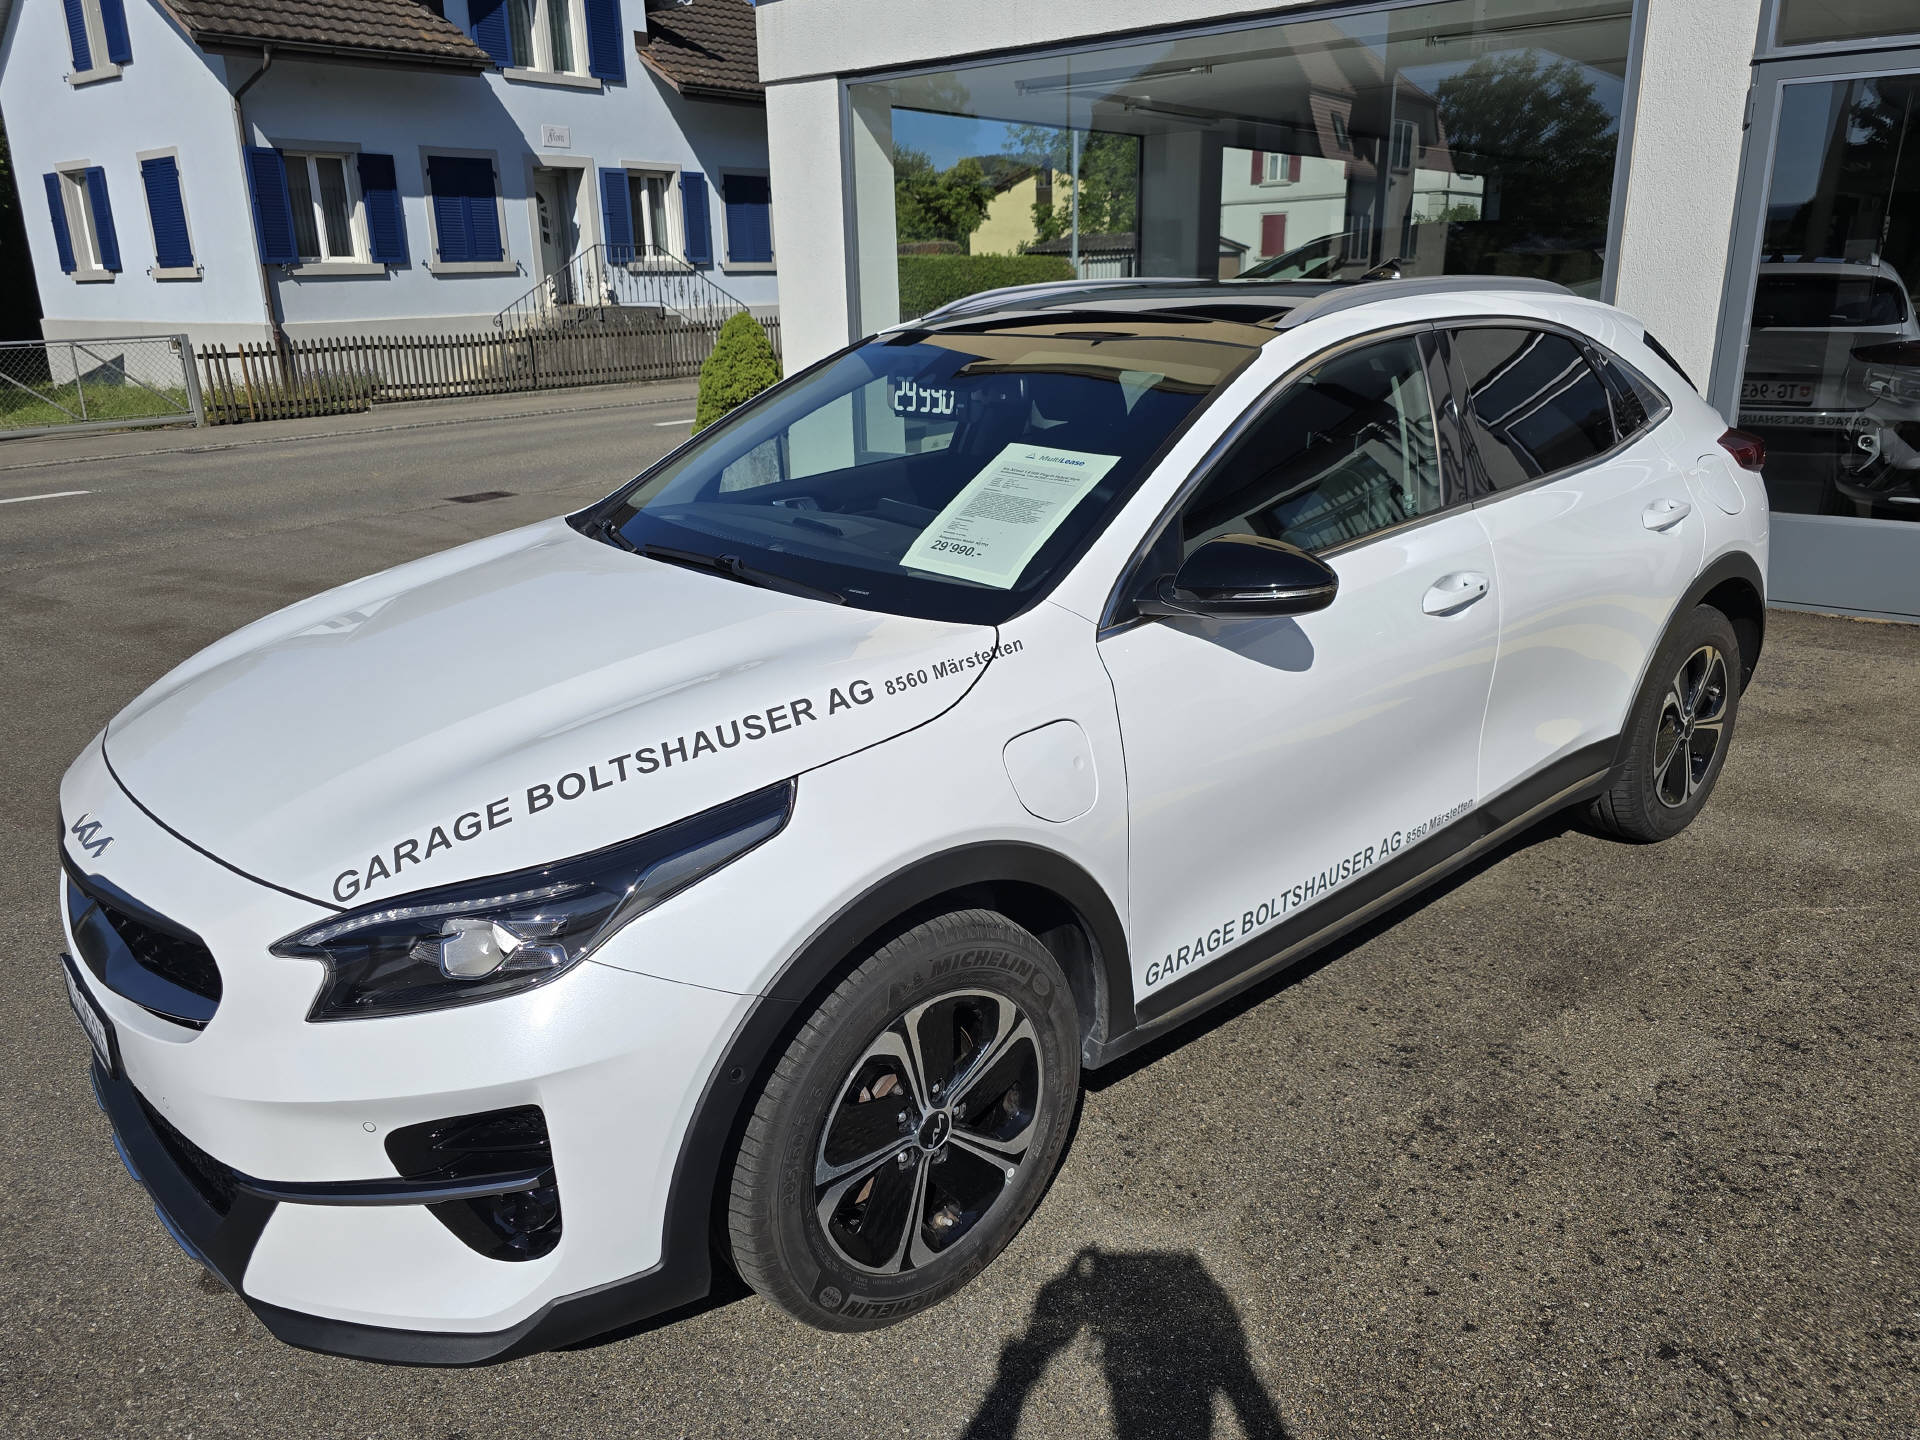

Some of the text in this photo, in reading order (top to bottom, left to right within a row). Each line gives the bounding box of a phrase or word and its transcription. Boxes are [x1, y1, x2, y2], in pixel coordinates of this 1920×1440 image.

[1038, 454, 1085, 467] MultiLease
[332, 639, 1024, 902] GARAGE BOLTSHAUSER AG 8560 Märstetten
[1145, 919, 1236, 988] GARAGE
[1241, 846, 1374, 937] BOLTSHAUSER
[1378, 830, 1402, 862] AG
[1405, 822, 1428, 844] 8560
[931, 950, 1034, 979] MICHELIN
